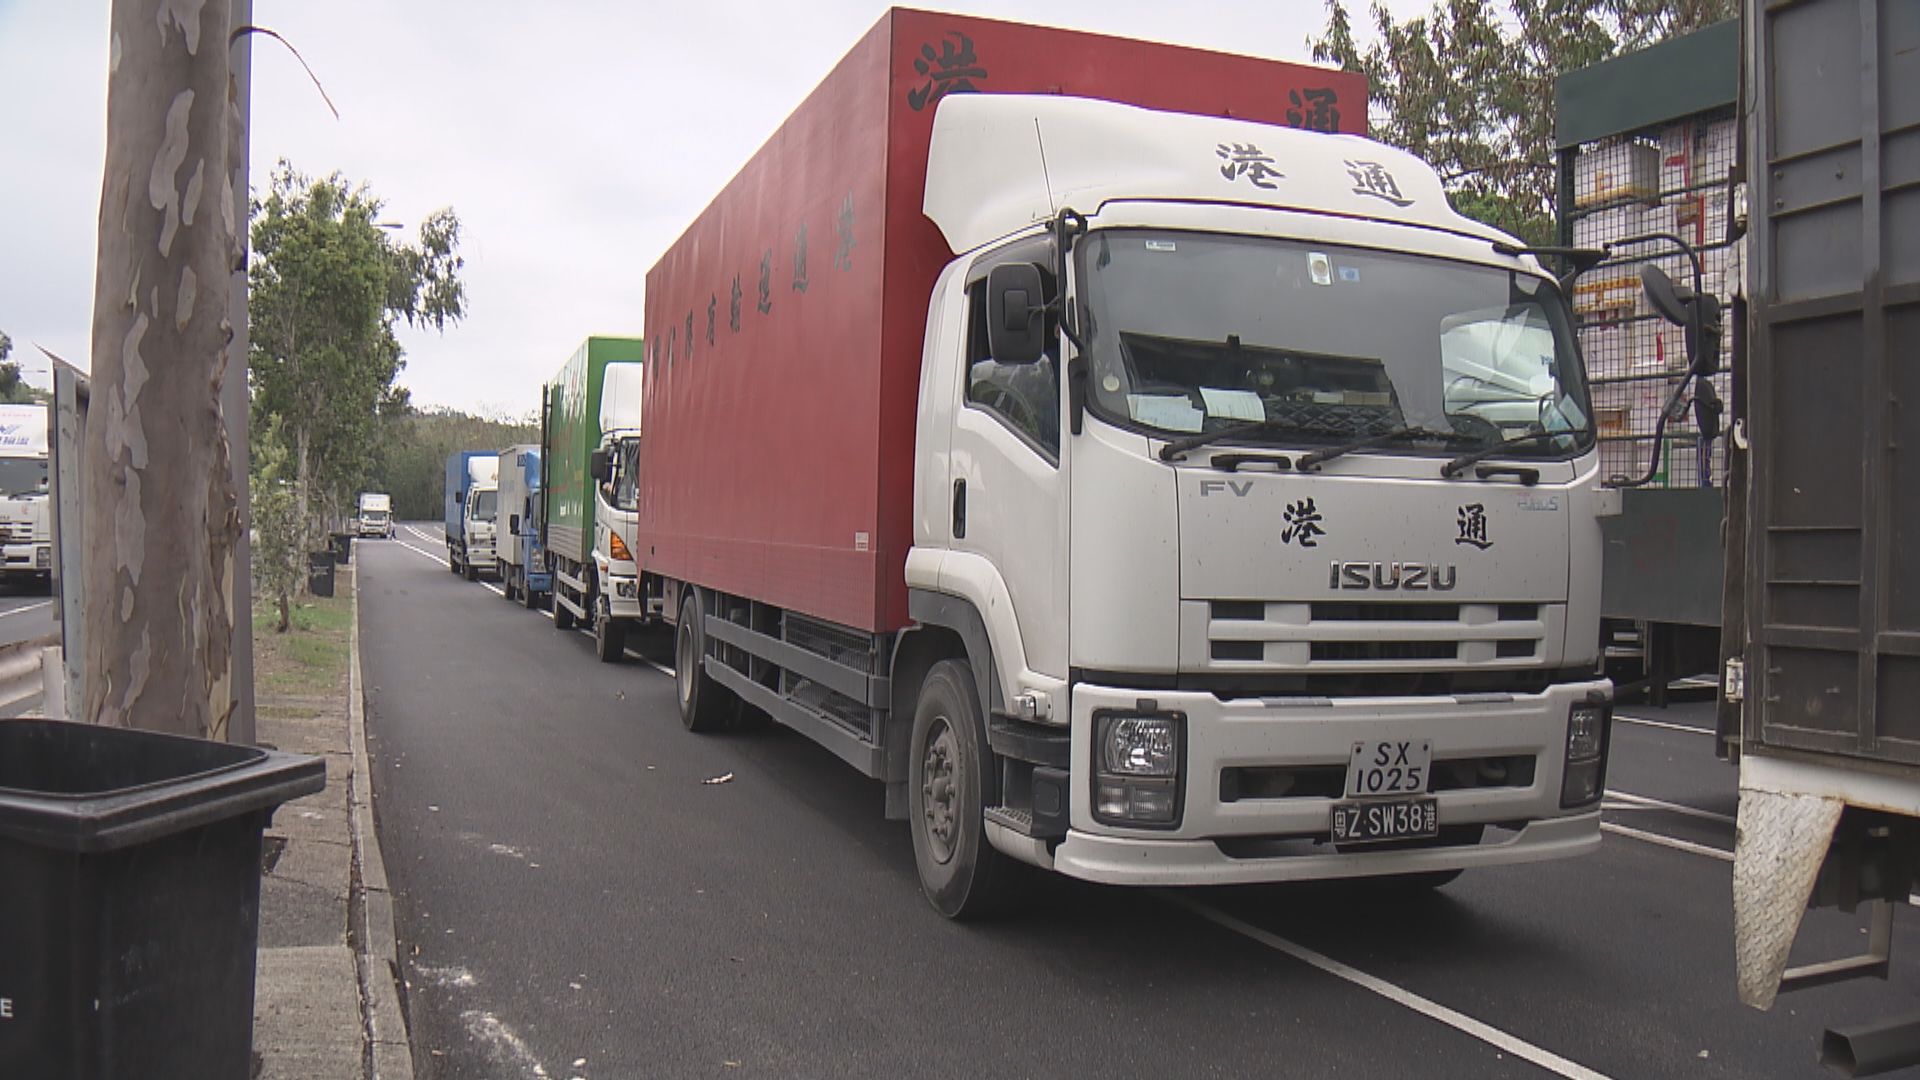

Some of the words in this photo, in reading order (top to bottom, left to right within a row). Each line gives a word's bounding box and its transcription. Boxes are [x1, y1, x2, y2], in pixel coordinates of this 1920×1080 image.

[1200, 480, 1254, 497] FV
[1329, 560, 1456, 590] ISUZU
[1374, 742, 1410, 767] SX
[1357, 767, 1421, 793] 1025
